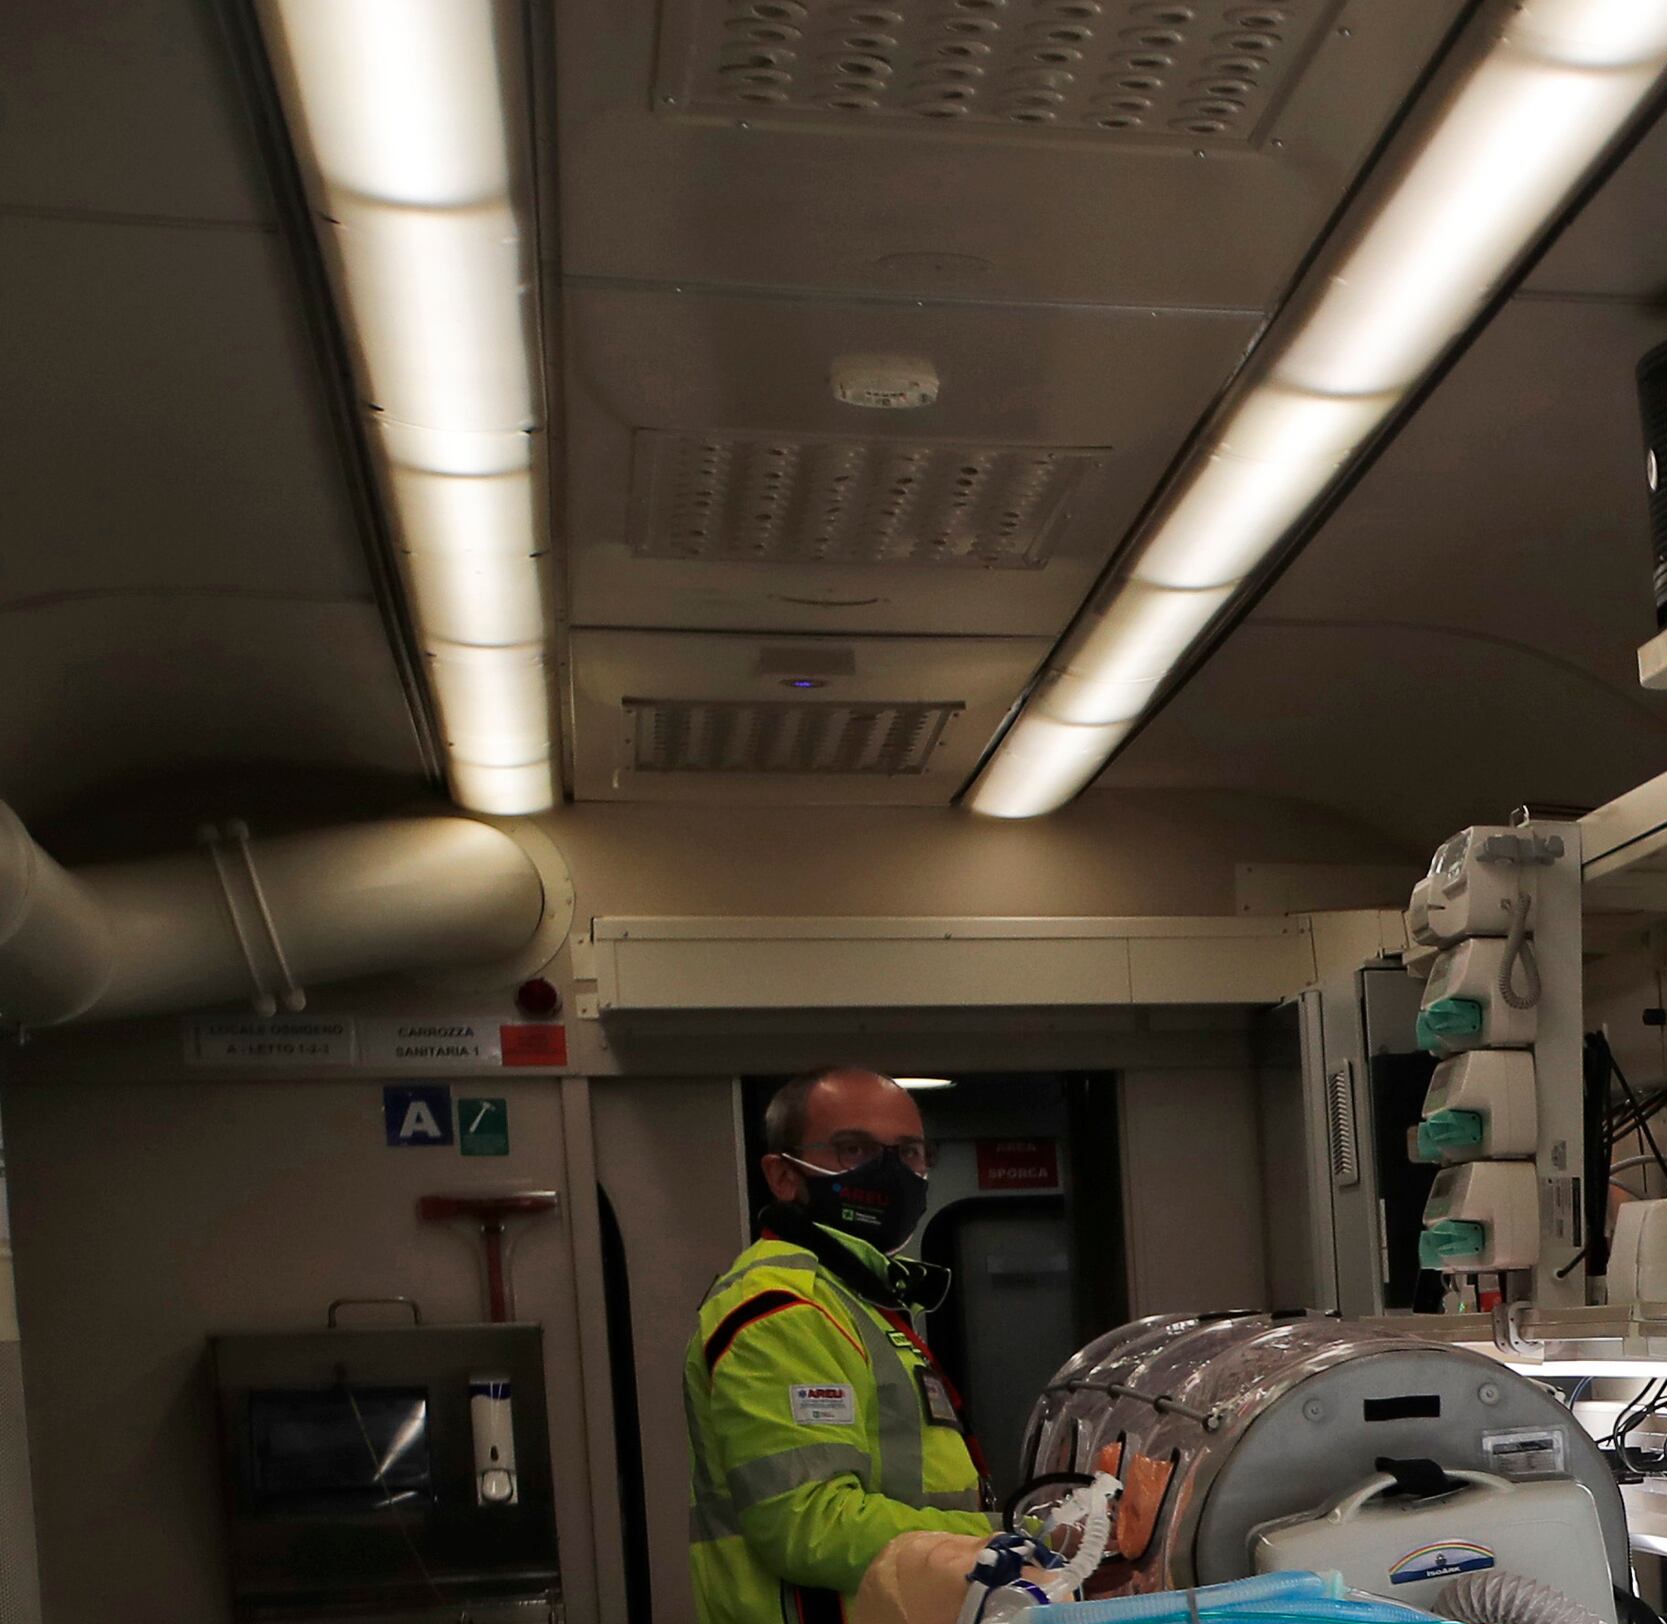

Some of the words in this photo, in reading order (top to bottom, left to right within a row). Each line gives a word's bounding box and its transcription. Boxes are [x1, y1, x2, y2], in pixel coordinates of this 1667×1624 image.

[398, 1026, 474, 1038] CARROZZA
[396, 1045, 469, 1057] SANITARIA
[399, 1100, 442, 1138] A
[996, 1142, 1037, 1153] AREA
[988, 1167, 1049, 1179] SPORCA
[808, 1388, 844, 1399] AREU
